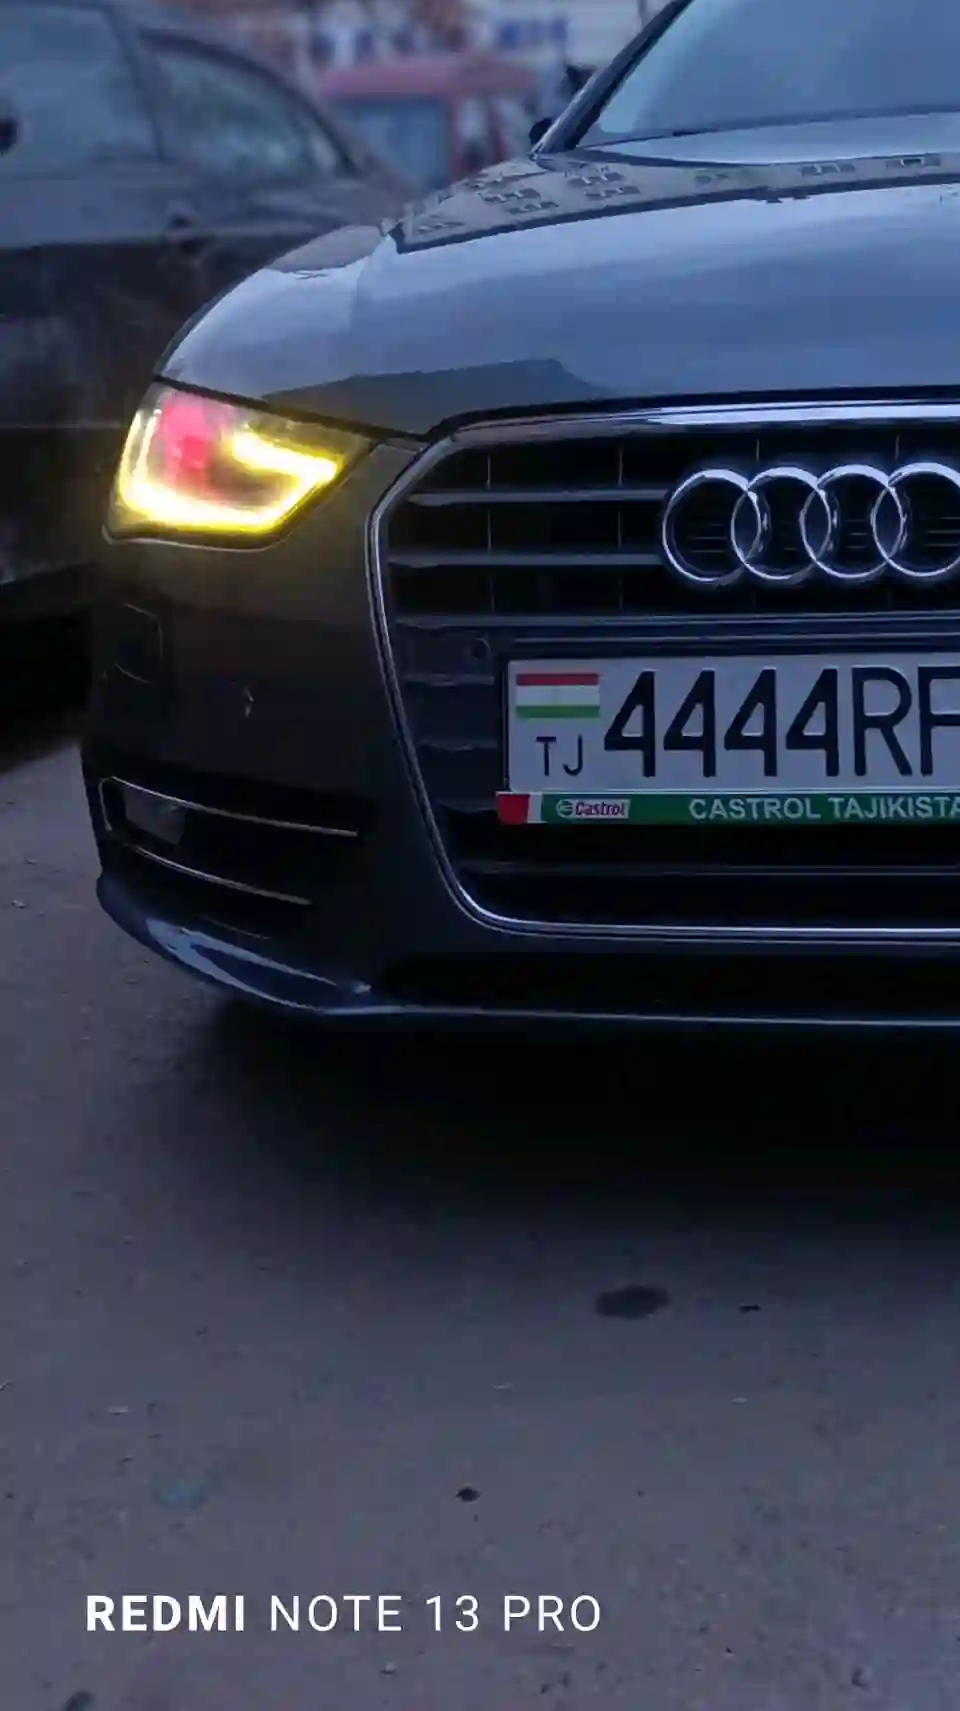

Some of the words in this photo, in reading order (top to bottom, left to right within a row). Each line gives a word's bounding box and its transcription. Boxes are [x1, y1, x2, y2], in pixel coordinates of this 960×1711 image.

[535, 735, 584, 777] TJ
[574, 799, 627, 818] Castrol
[688, 797, 822, 820] CASTROL
